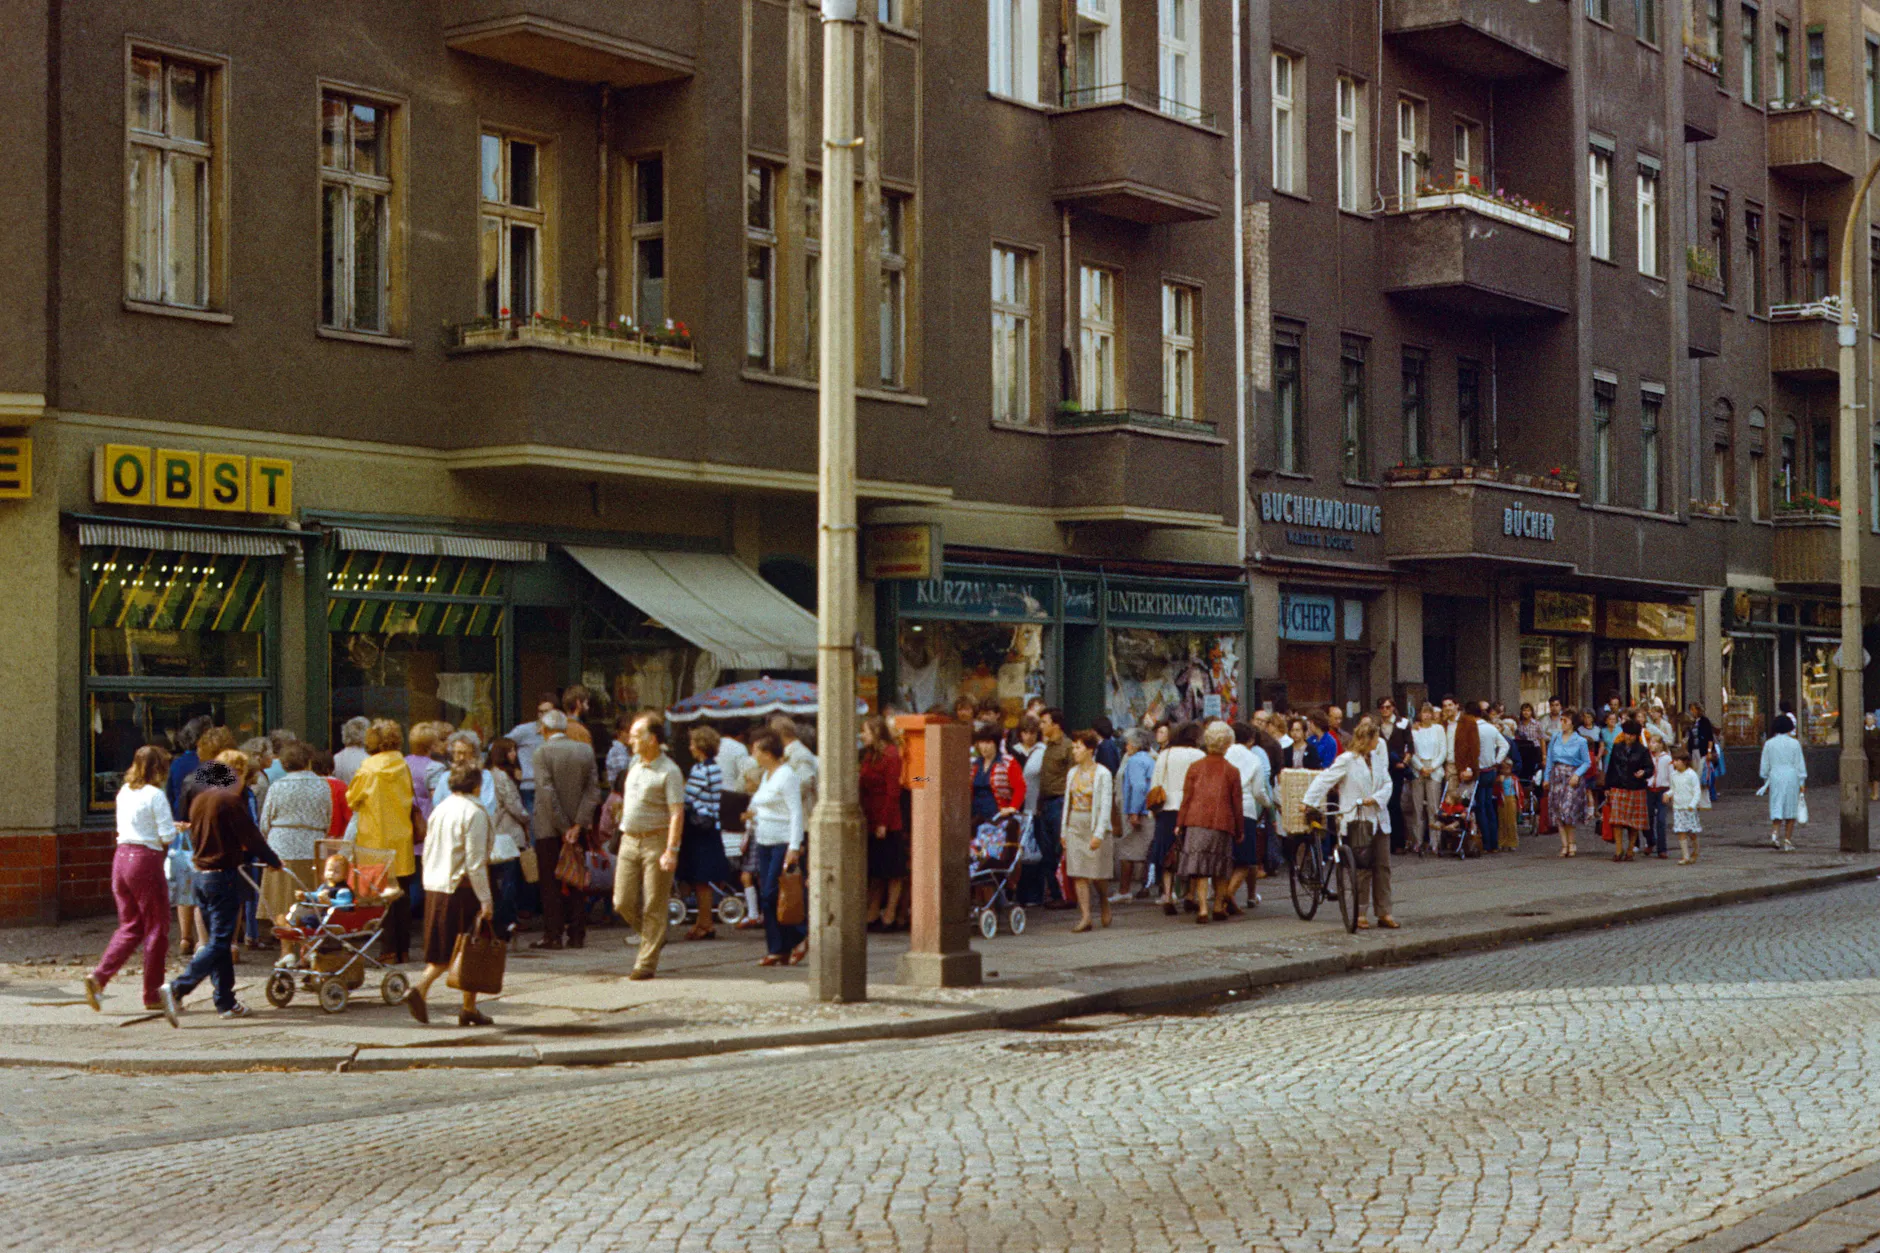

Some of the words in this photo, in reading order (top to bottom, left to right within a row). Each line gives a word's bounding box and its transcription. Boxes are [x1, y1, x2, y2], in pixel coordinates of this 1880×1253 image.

[113, 453, 285, 507] OBST
[1261, 492, 1382, 534] BUCHHANDLUNG
[1503, 501, 1555, 541] BÜCHER
[1107, 590, 1238, 617] UNTERTRIKOTAGEN
[1280, 595, 1332, 632] ÜCHER
